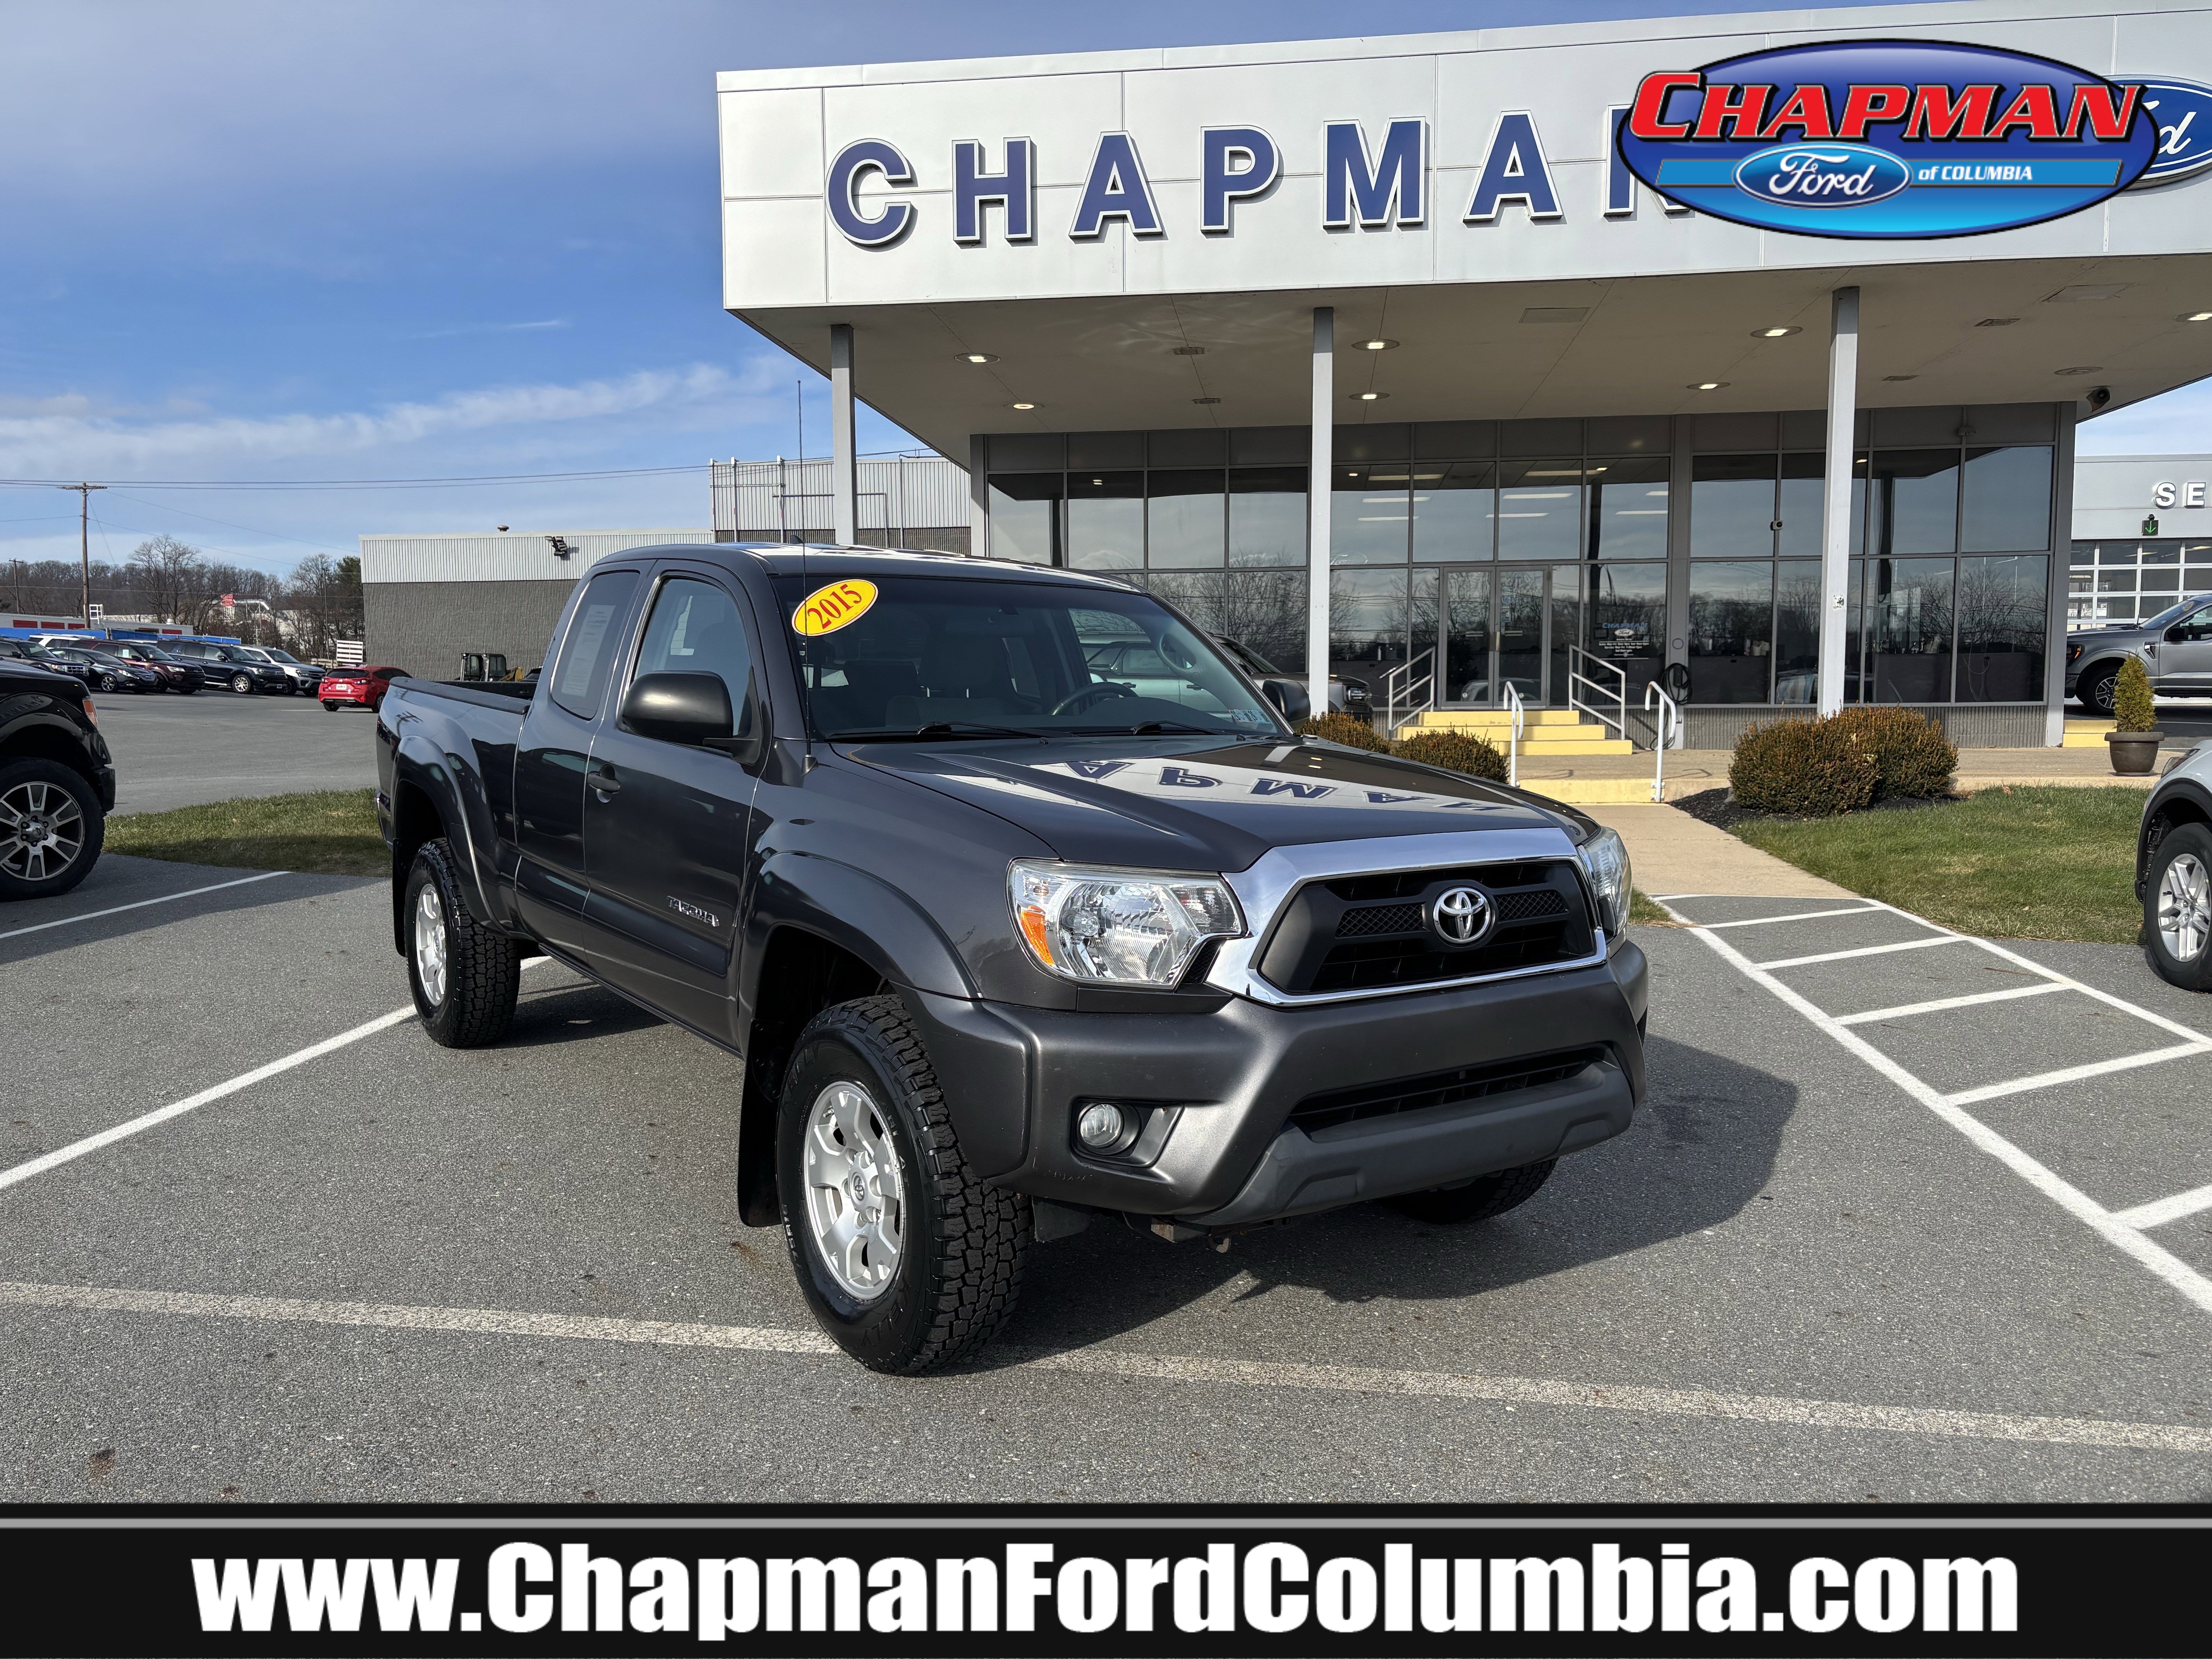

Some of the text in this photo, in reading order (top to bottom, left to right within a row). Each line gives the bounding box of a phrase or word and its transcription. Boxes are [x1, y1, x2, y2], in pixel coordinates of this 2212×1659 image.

[825, 104, 1690, 248] CHAPMA
[807, 584, 862, 630] 2015
[666, 895, 720, 927] TACOMA
